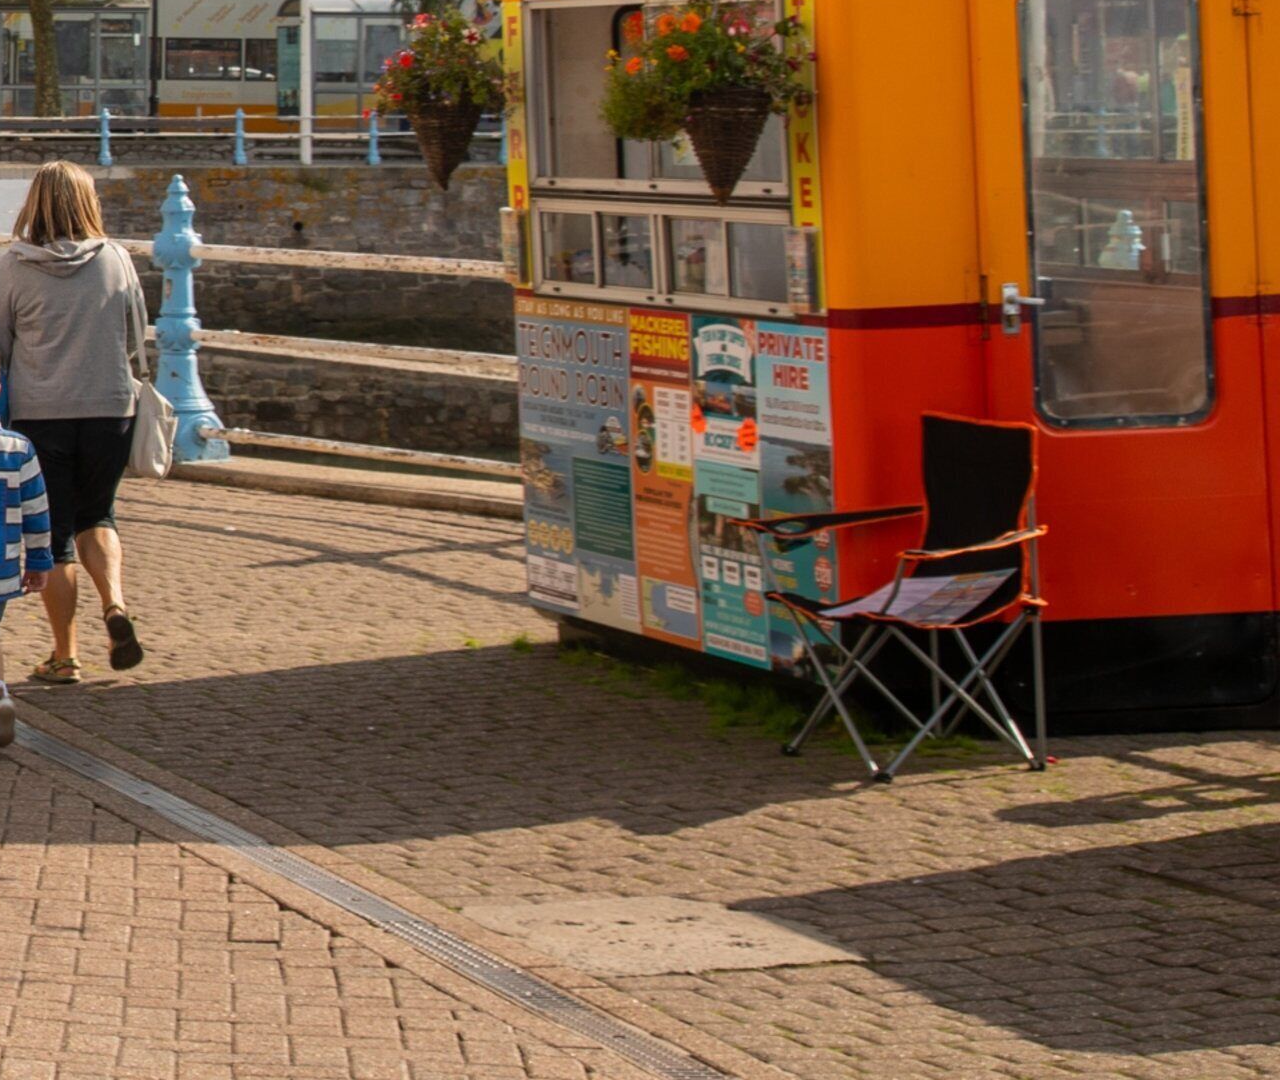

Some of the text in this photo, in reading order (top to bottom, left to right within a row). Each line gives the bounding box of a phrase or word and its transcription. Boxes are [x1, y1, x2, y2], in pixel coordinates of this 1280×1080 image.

[537, 302, 547, 315] AS
[549, 303, 571, 317] LONG
[574, 305, 584, 319] AS
[587, 307, 604, 320] YOU
[630, 314, 688, 337] MACKEREL
[518, 321, 625, 371] TEIGNMOUTH
[630, 333, 689, 361] FISHING
[758, 332, 824, 362] PRIVATE
[773, 364, 809, 390] HIRE
